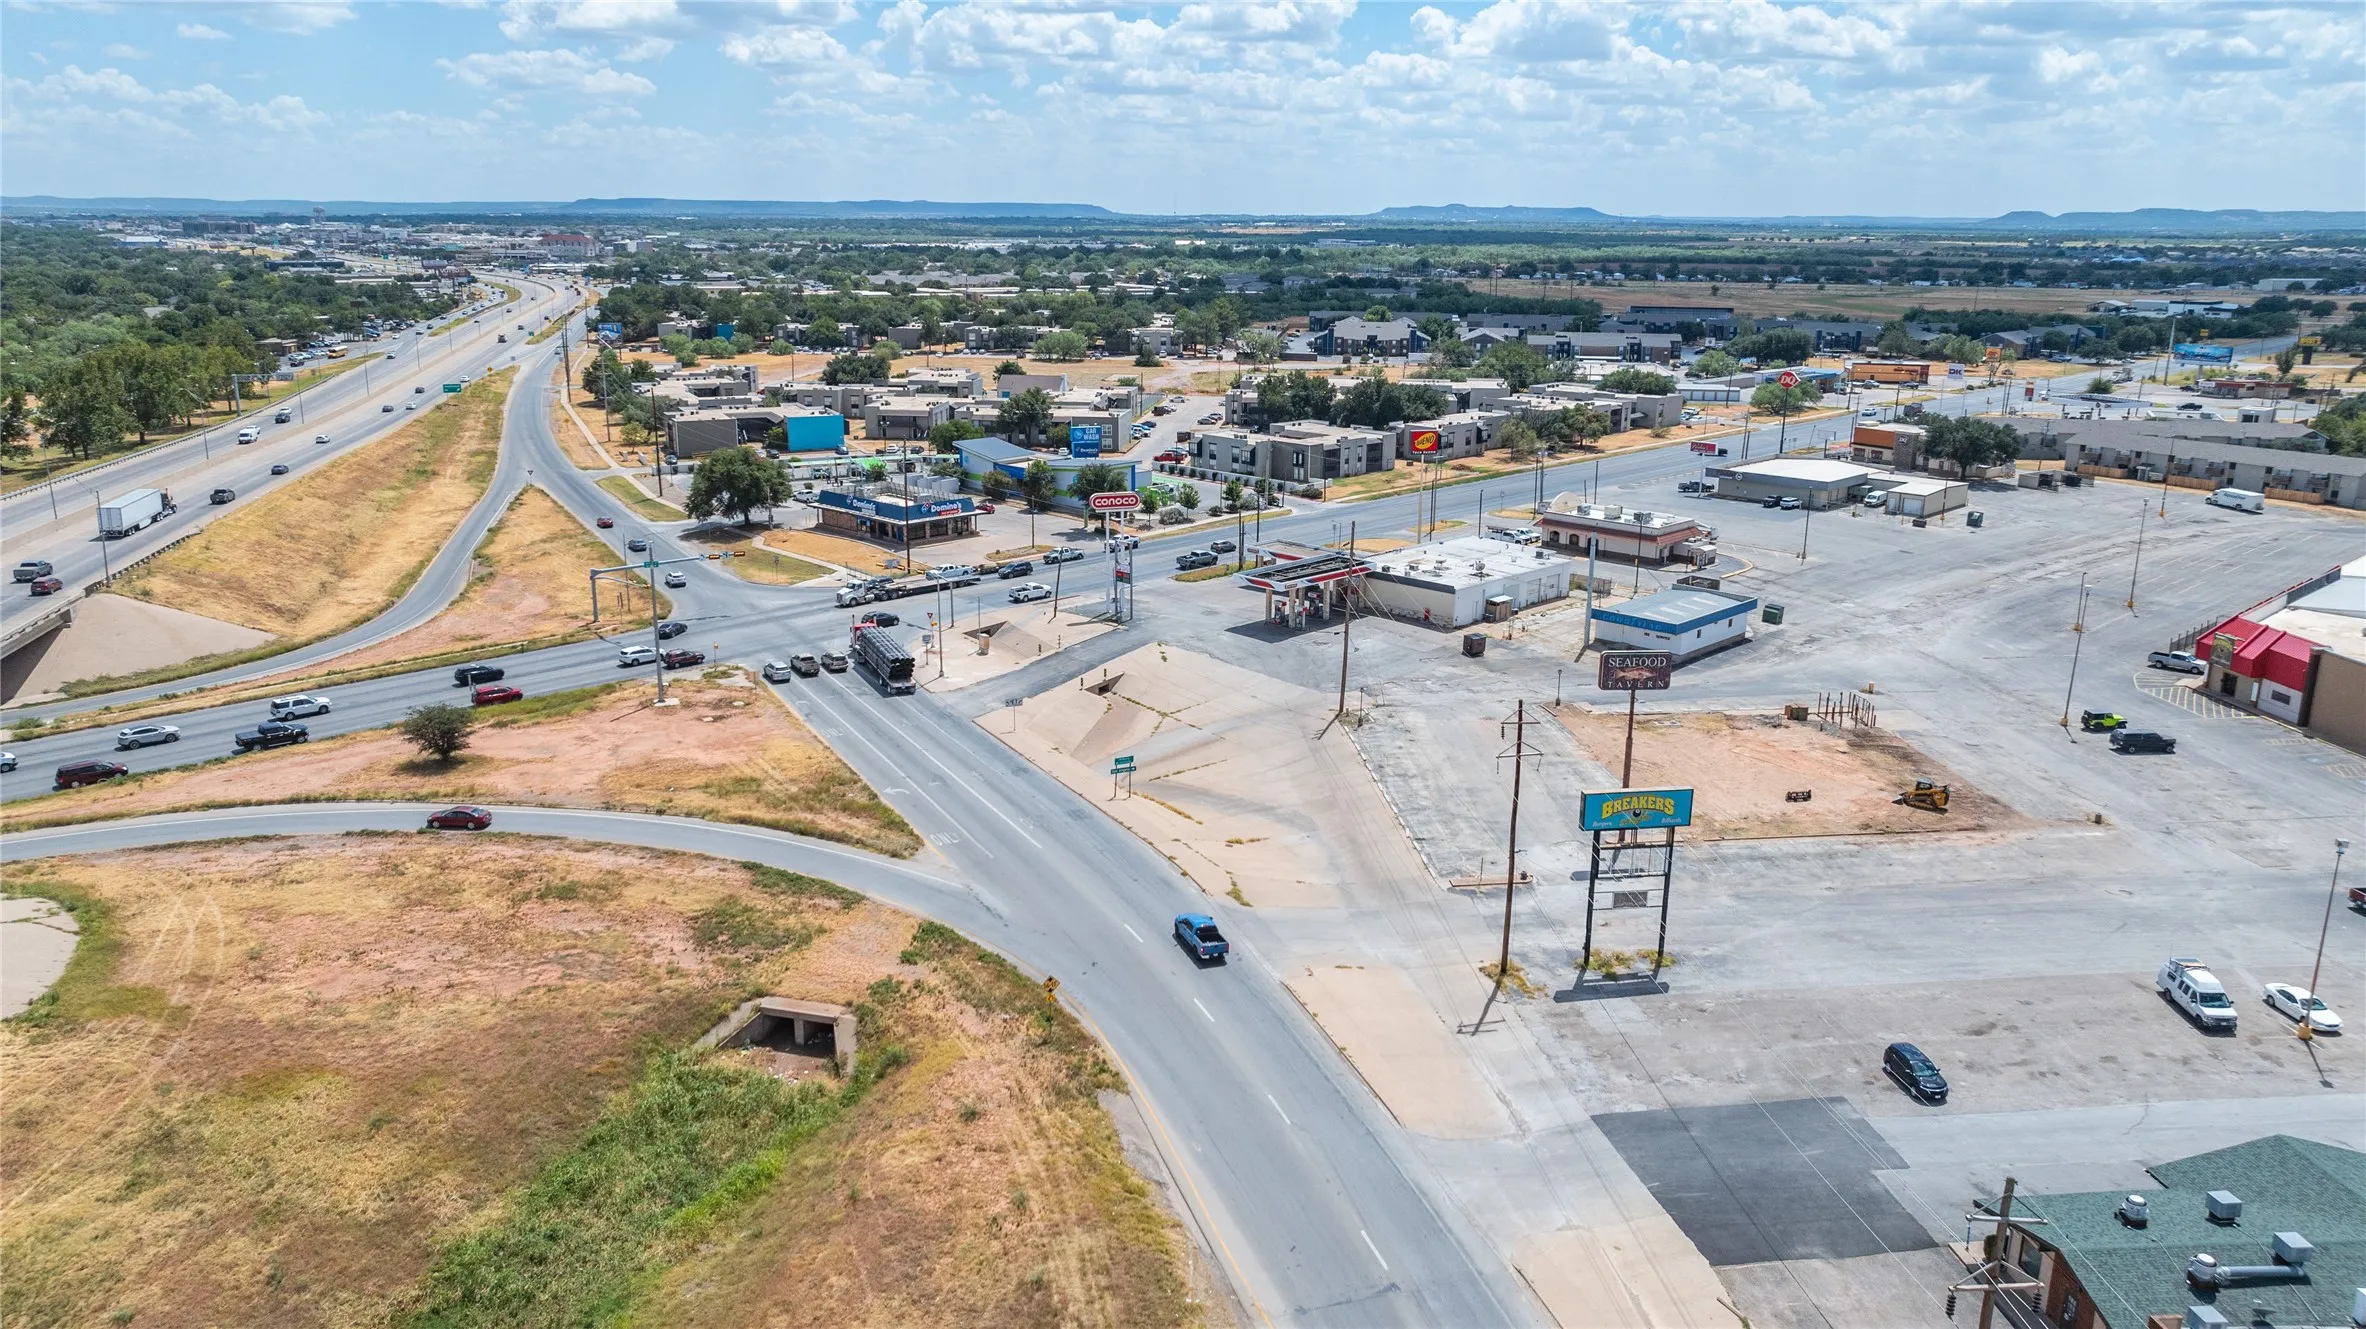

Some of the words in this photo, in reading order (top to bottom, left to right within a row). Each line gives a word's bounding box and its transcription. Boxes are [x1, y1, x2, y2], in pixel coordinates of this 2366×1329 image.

[1781, 375, 1796, 385] DQ
[852, 499, 876, 511] Domino's
[930, 501, 962, 513] Domino's
[1608, 657, 1667, 667] SEAFOOD
[1607, 680, 1665, 688] TAVERN
[1602, 796, 1675, 819] BREAKERS
[930, 831, 960, 846] ONLY
